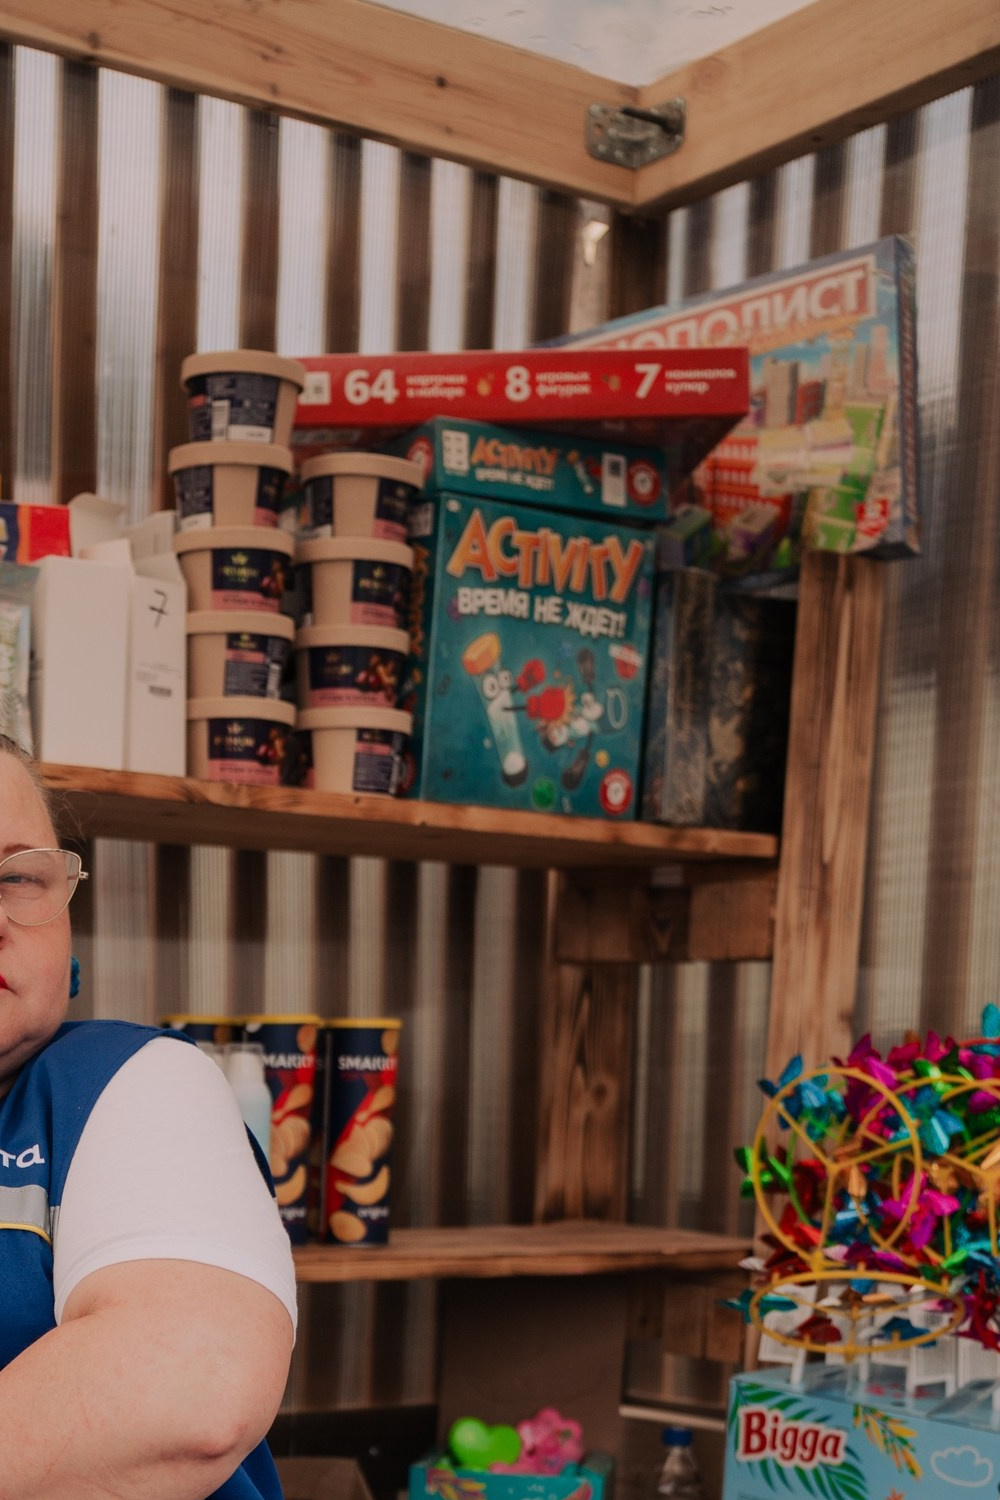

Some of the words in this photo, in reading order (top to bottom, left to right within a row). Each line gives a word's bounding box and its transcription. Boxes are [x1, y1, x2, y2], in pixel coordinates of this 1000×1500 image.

[619, 267, 868, 349] ПОЛИСТ
[345, 369, 399, 405] 64
[505, 366, 531, 402] 8
[635, 363, 662, 399] 7
[471, 436, 558, 474] ACTIVITY
[446, 507, 644, 603] ACTIVITY
[148, 588, 169, 629] 7
[457, 587, 530, 619] ВРЕМЯ
[534, 595, 564, 624] НЕ
[564, 601, 628, 639] ЖДЕТ!
[739, 1407, 844, 1466] Bigga
